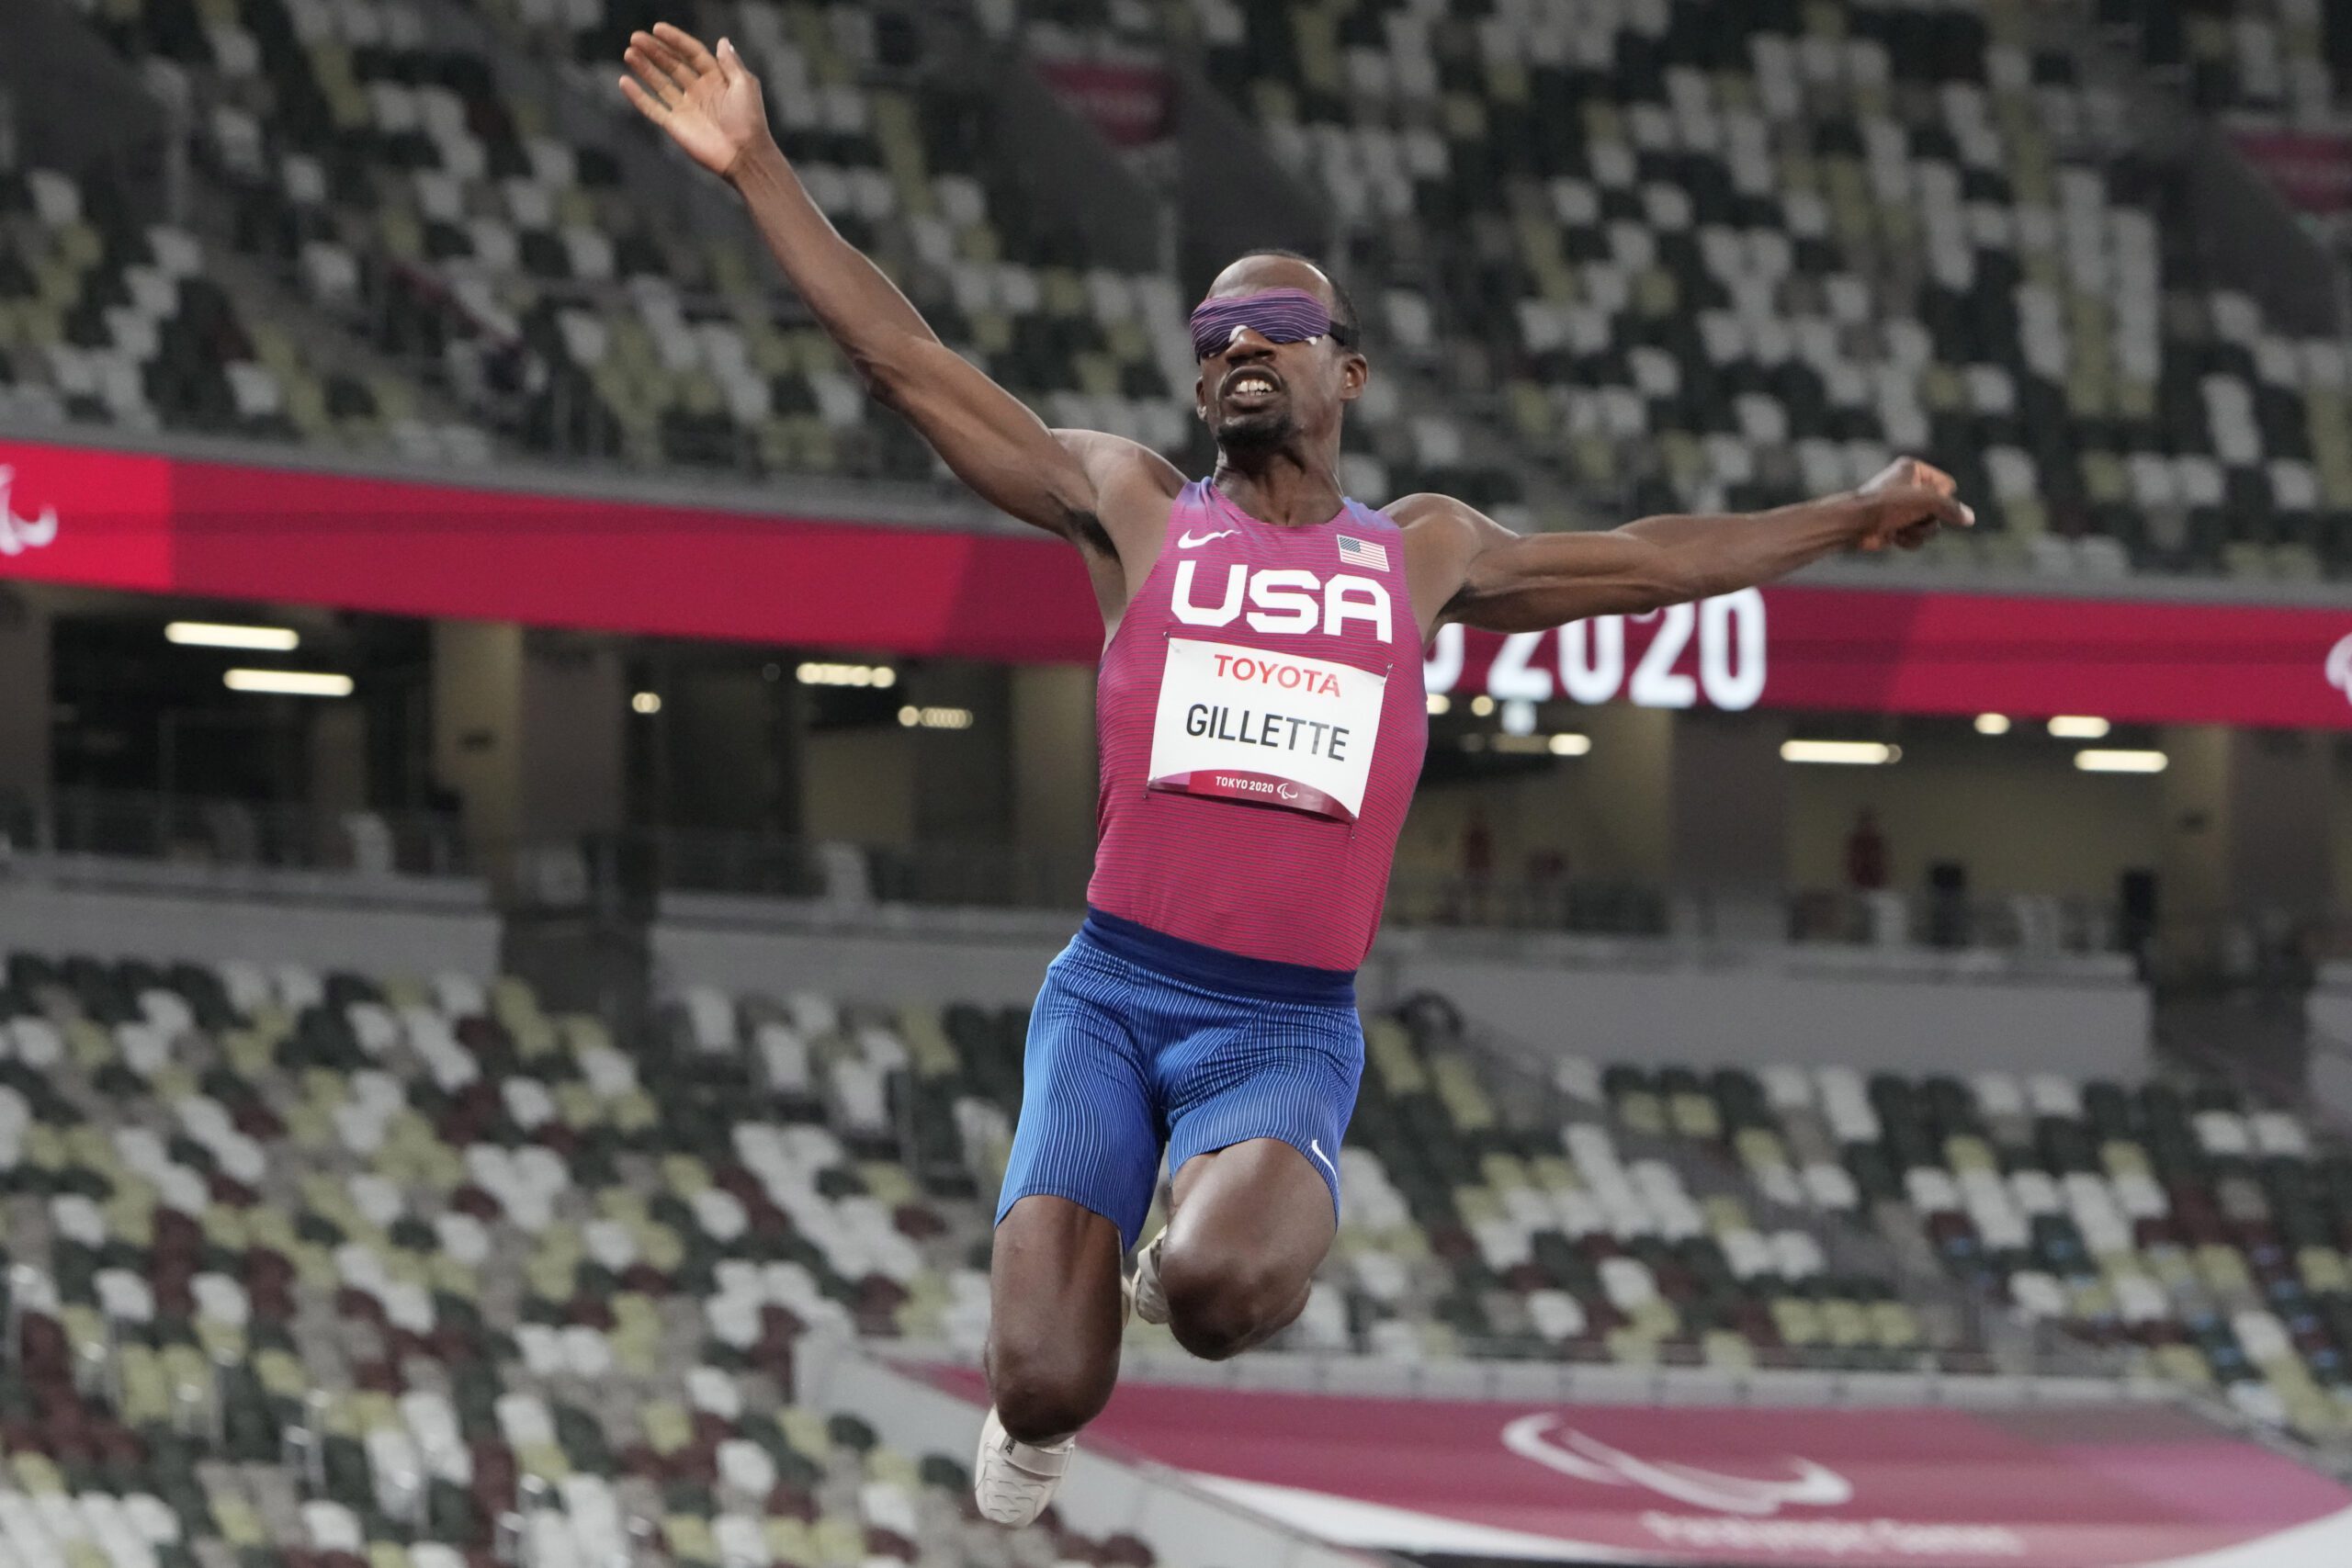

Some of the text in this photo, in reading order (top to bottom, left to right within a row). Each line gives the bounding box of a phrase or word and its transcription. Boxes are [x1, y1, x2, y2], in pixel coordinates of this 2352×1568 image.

[1170, 559, 1393, 644] USA
[1214, 653, 1341, 698] TOYOTA
[1486, 586, 1768, 711] 2020
[1185, 703, 1351, 762] GILLETTE
[1216, 775, 1274, 794] TOKYO 2020
